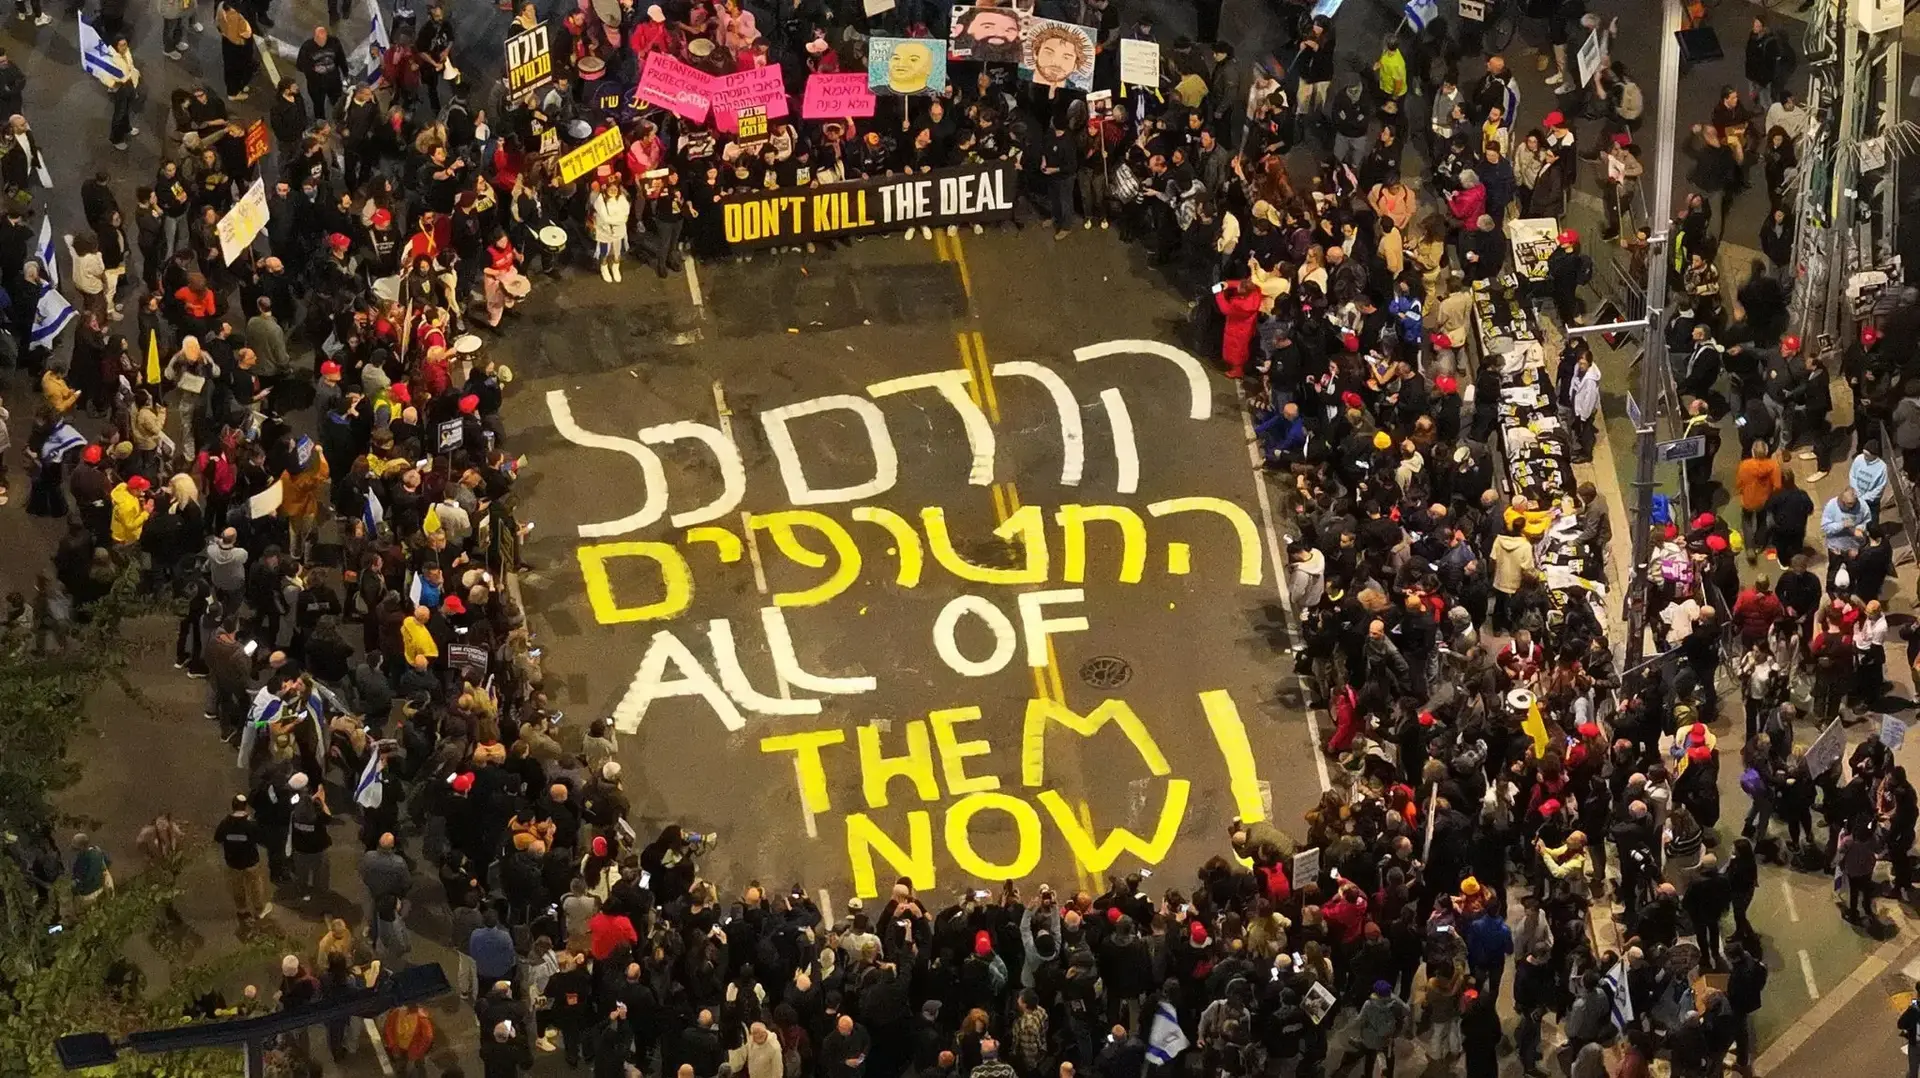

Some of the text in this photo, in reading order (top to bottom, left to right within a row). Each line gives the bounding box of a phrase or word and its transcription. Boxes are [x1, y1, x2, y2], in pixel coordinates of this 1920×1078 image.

[507, 25, 549, 71] כולם
[653, 56, 711, 84] NETANYAHU
[723, 168, 1013, 243] DON'T KILL THE DEAL
[546, 339, 1213, 538] קודם כל
[577, 495, 1263, 625] החטופים
[612, 588, 1090, 735] ALL OF
[760, 697, 1173, 814] THEM
